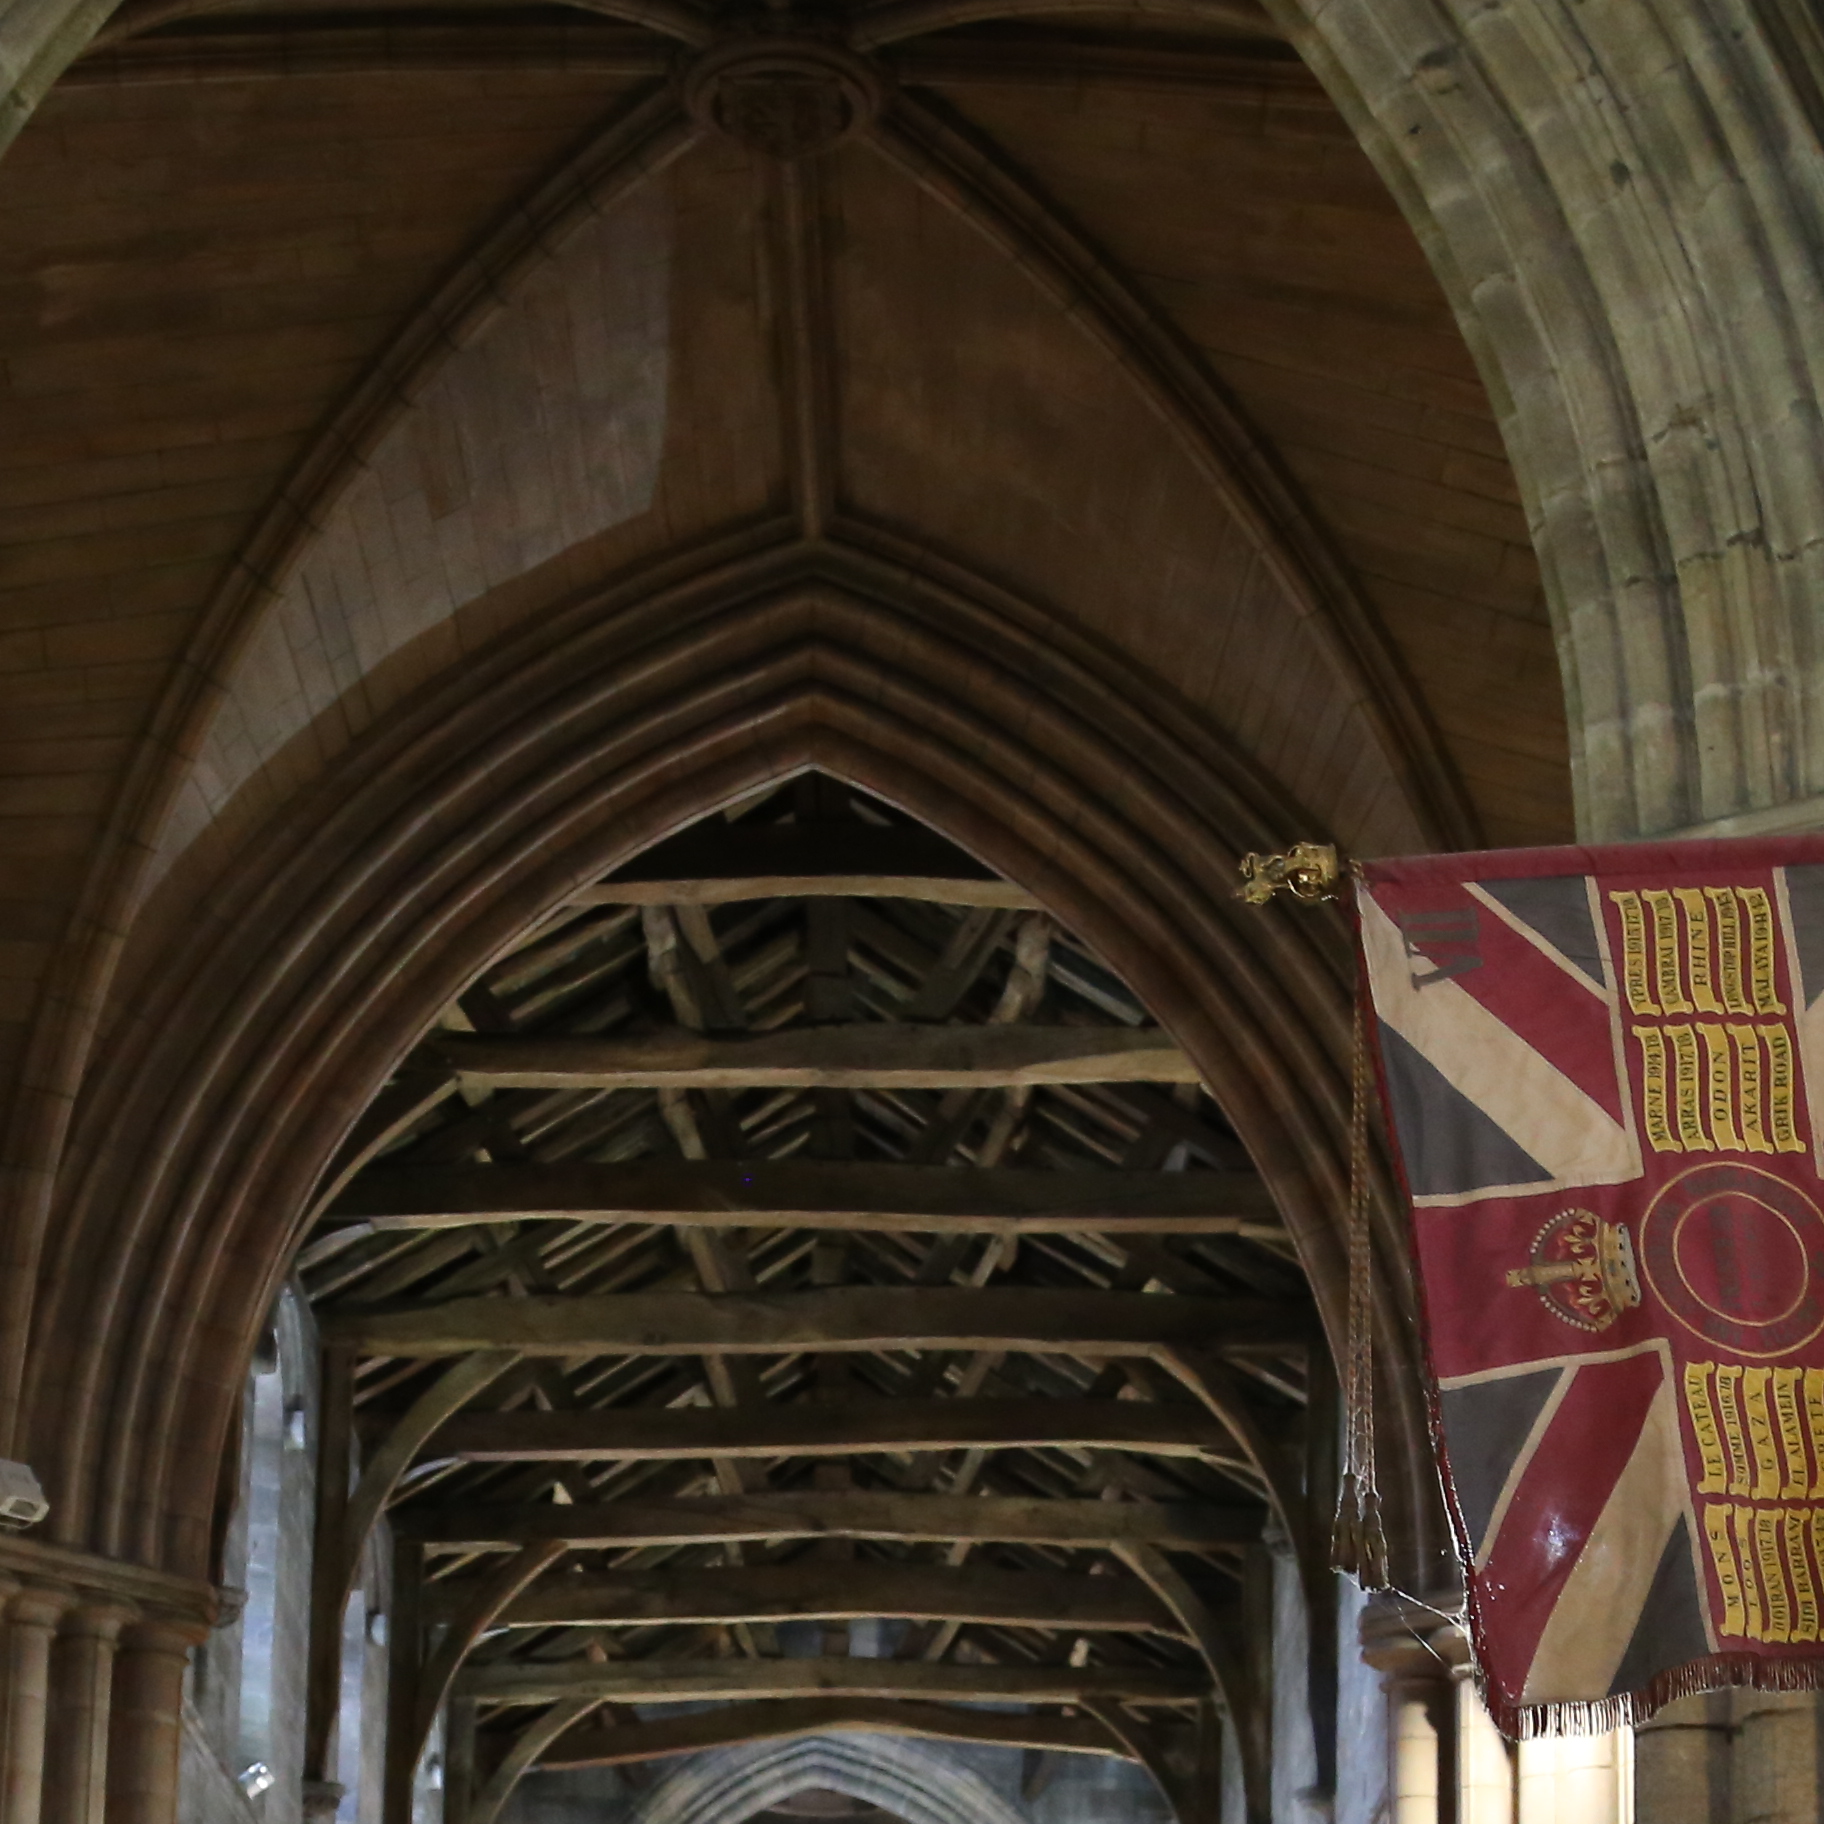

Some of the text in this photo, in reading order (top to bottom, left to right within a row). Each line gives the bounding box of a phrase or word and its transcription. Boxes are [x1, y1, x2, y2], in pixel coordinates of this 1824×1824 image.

[1397, 906, 1484, 992] VII
[1690, 911, 1707, 985] RHINE
[1722, 922, 1735, 949] HILL
[1628, 959, 1647, 1007] YPRES
[1660, 946, 1677, 1004] CAMBRAI
[1723, 950, 1741, 1008] LONGSTOP
[1754, 945, 1773, 1007] MALAYA
[1648, 1086, 1667, 1141] MARNE
[1680, 1089, 1699, 1140] ARRAS
[1712, 1050, 1727, 1121] ODON
[1741, 1042, 1757, 1132] AKARIT
[1772, 1036, 1791, 1141] GRIK ROAD
[1689, 1375, 1723, 1477] LE CATEAU
[1729, 1432, 1748, 1485] SOMME
[1750, 1391, 1773, 1471] GAZA
[1777, 1381, 1805, 1486] EL ALAMEIN
[1710, 1529, 1740, 1608] MONS
[1739, 1536, 1758, 1608] LOOS
[1763, 1572, 1786, 1631] DOIRAN
[1789, 1514, 1816, 1634] SIDI BARRANI
